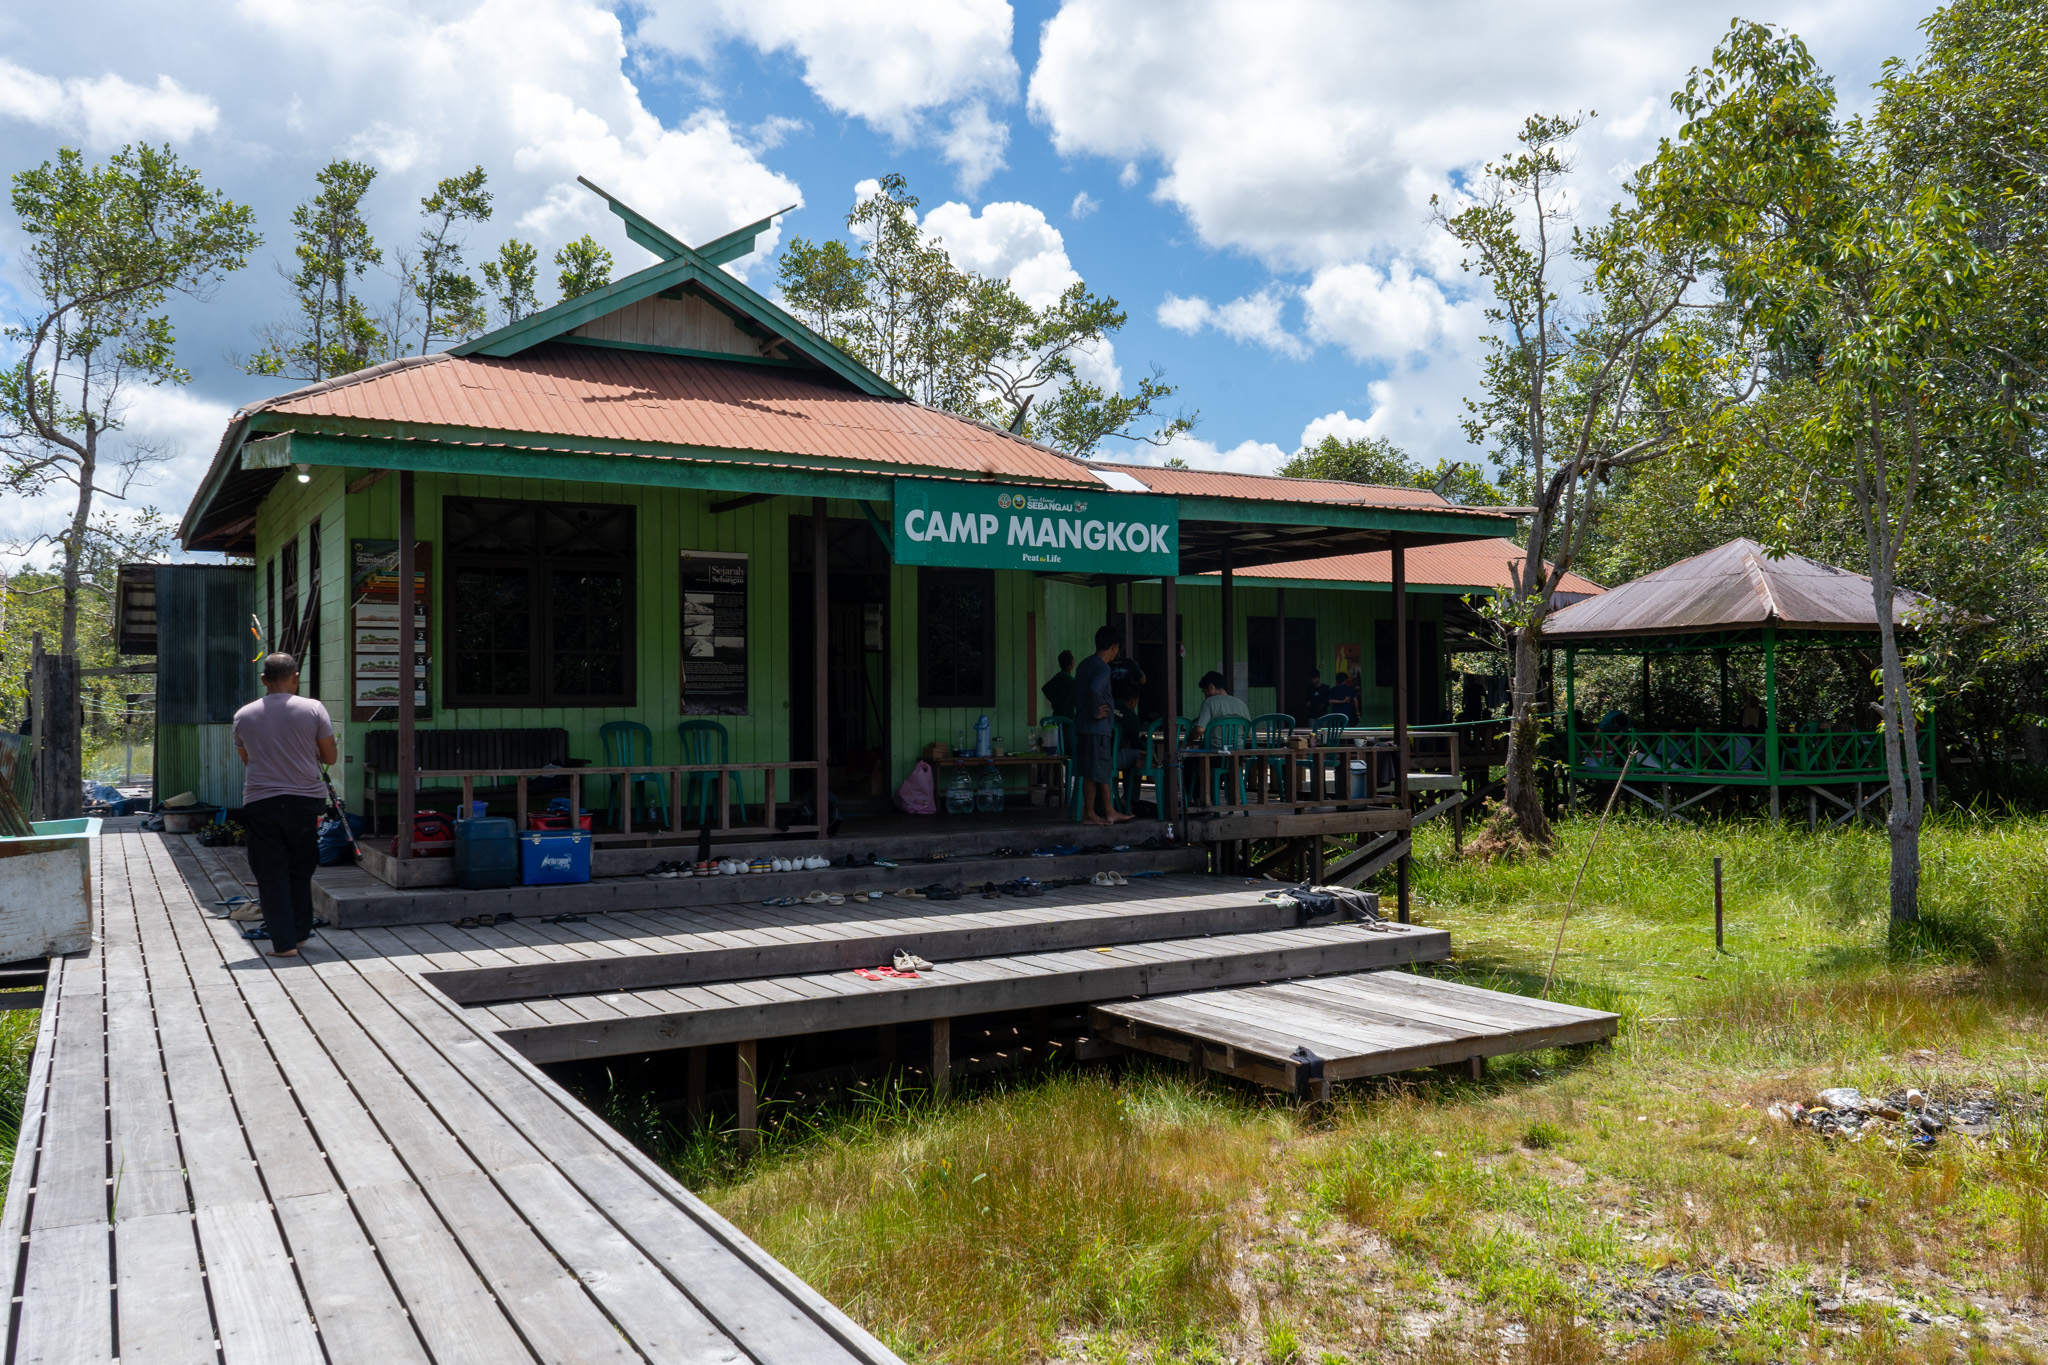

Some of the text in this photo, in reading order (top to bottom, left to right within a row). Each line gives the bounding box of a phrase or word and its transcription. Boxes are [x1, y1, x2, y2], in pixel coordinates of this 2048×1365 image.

[1027, 502, 1073, 512] SEBANGAU
[904, 508, 1170, 554] CAMP MANGKOK
[1022, 553, 1039, 562] Peat
[1046, 554, 1061, 563] Life
[711, 565, 744, 576] Sejarah
[711, 575, 744, 585] Sebangau
[418, 607, 424, 615] 1
[417, 632, 424, 640] 2
[417, 657, 424, 665] 3
[417, 682, 424, 690] 4
